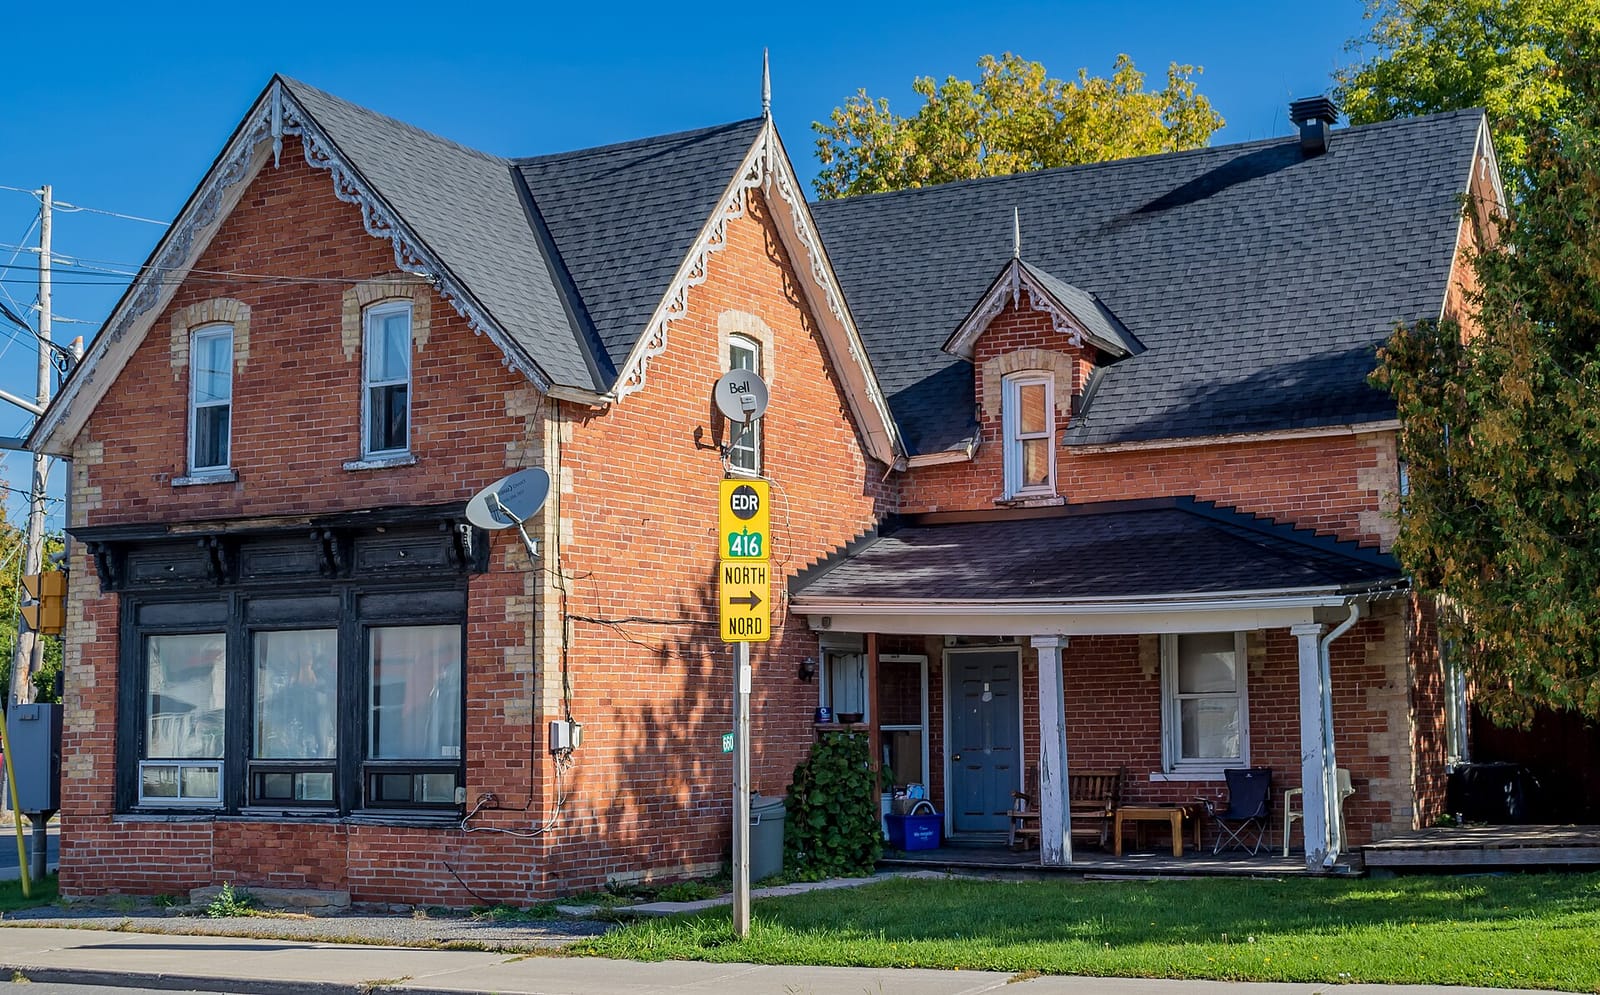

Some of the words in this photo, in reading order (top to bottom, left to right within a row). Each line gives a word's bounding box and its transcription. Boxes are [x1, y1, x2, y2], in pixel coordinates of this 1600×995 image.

[729, 381, 750, 394] Bell
[732, 494, 758, 510] EDR
[731, 535, 759, 556] 416
[725, 566, 765, 585] NORTH
[729, 617, 762, 635] NORD
